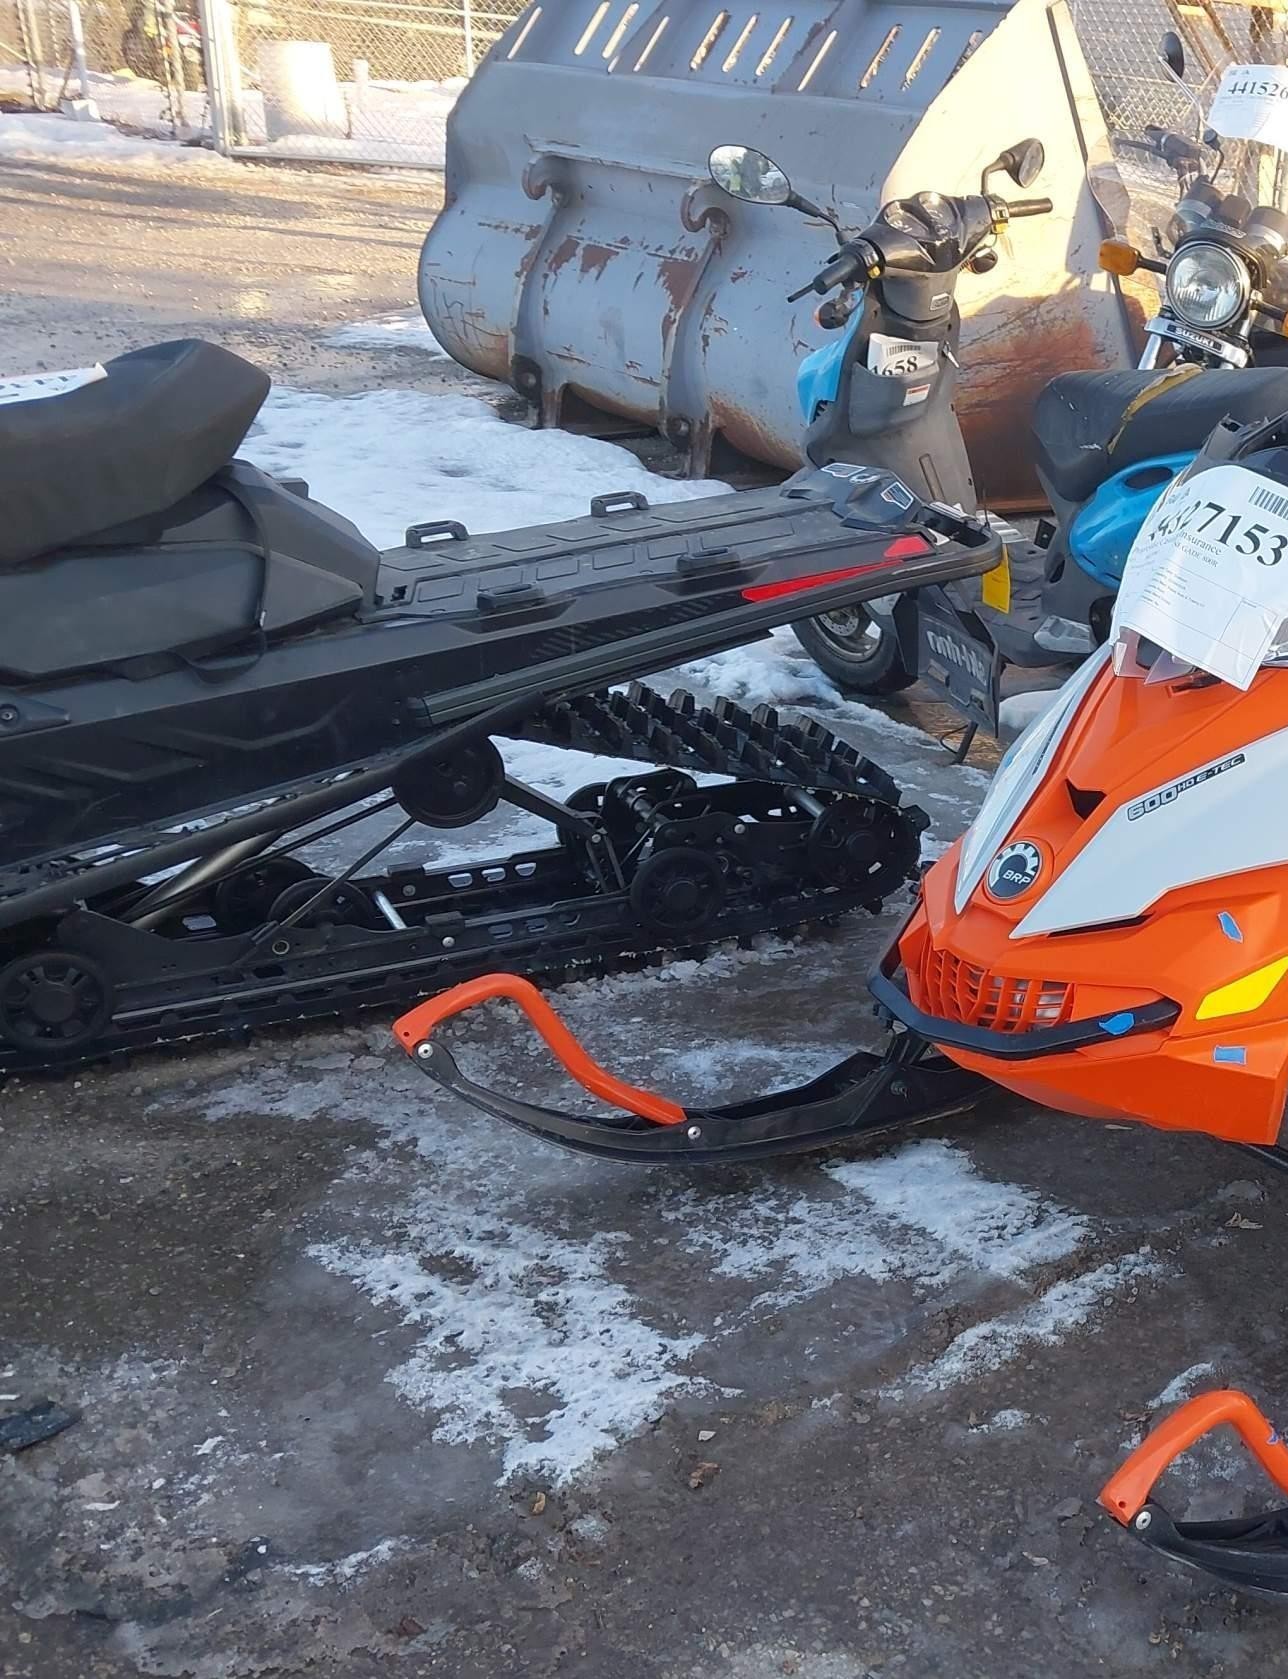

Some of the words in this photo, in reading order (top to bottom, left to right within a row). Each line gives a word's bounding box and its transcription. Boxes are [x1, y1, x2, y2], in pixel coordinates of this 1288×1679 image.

[1174, 327, 1215, 348] SUZUKI
[1127, 785, 1179, 822] 600
[1196, 754, 1244, 782] E-TEC
[1002, 869, 1031, 885] BRP
